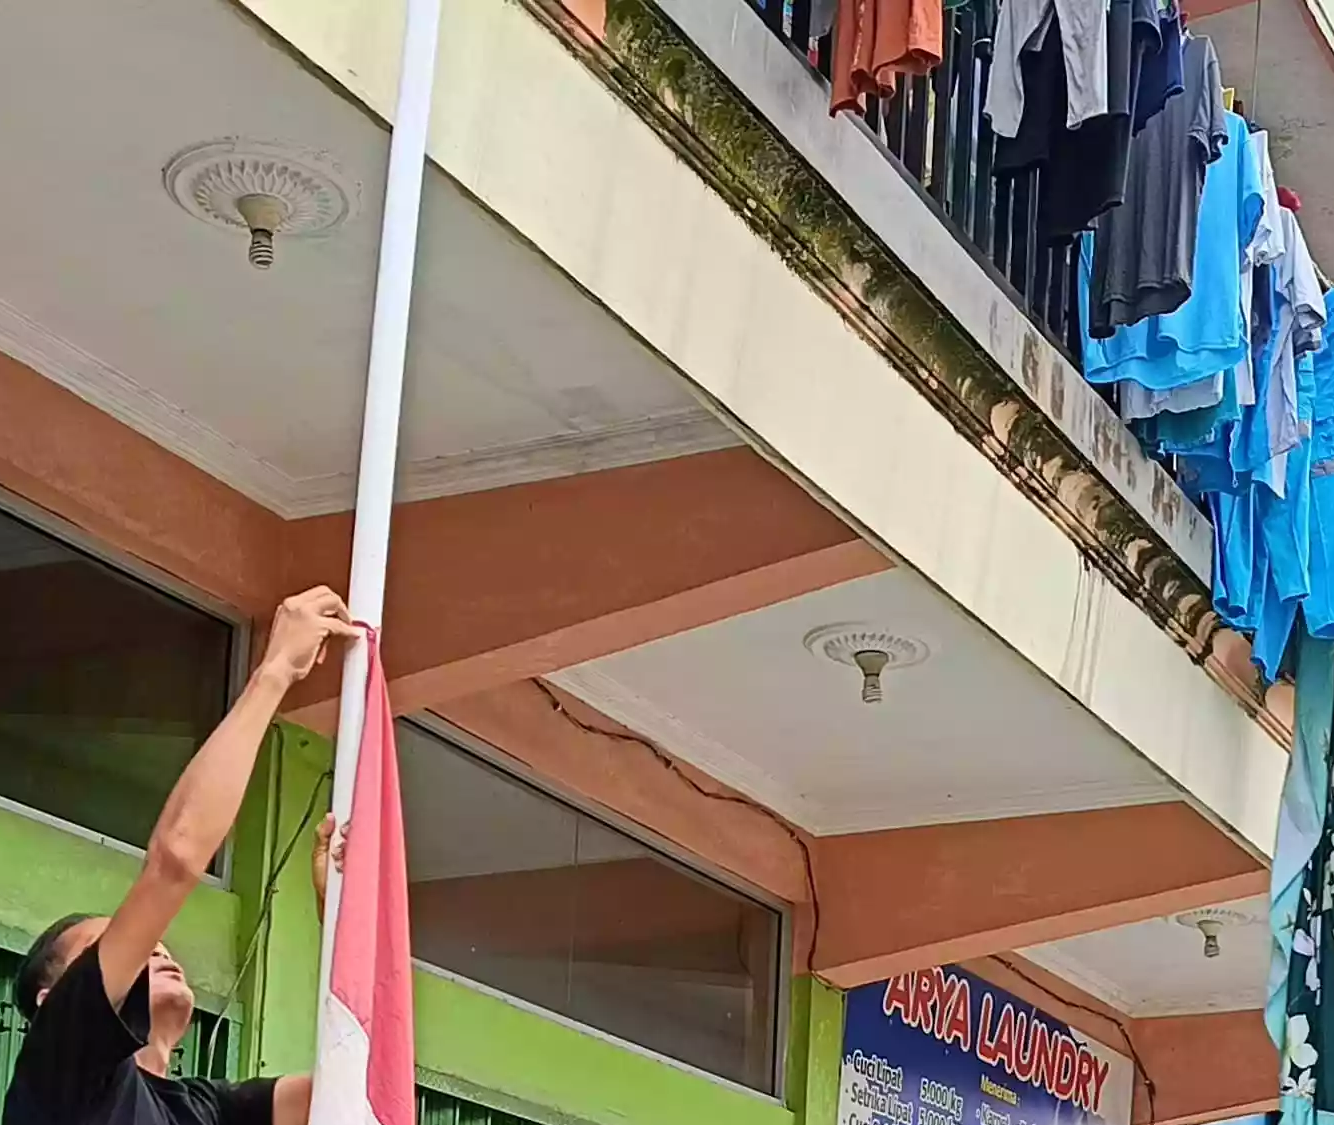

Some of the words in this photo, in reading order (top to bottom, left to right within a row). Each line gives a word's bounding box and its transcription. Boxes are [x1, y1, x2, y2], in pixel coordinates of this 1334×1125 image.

[884, 967, 970, 1052] ARYA
[976, 993, 1110, 1115] LAUNDRY
[853, 1051, 875, 1078] Cuci
[876, 1059, 903, 1091] Lipat
[850, 1082, 886, 1114] Setrika
[887, 1094, 913, 1125] Lipat
[948, 1087, 963, 1121] kg
